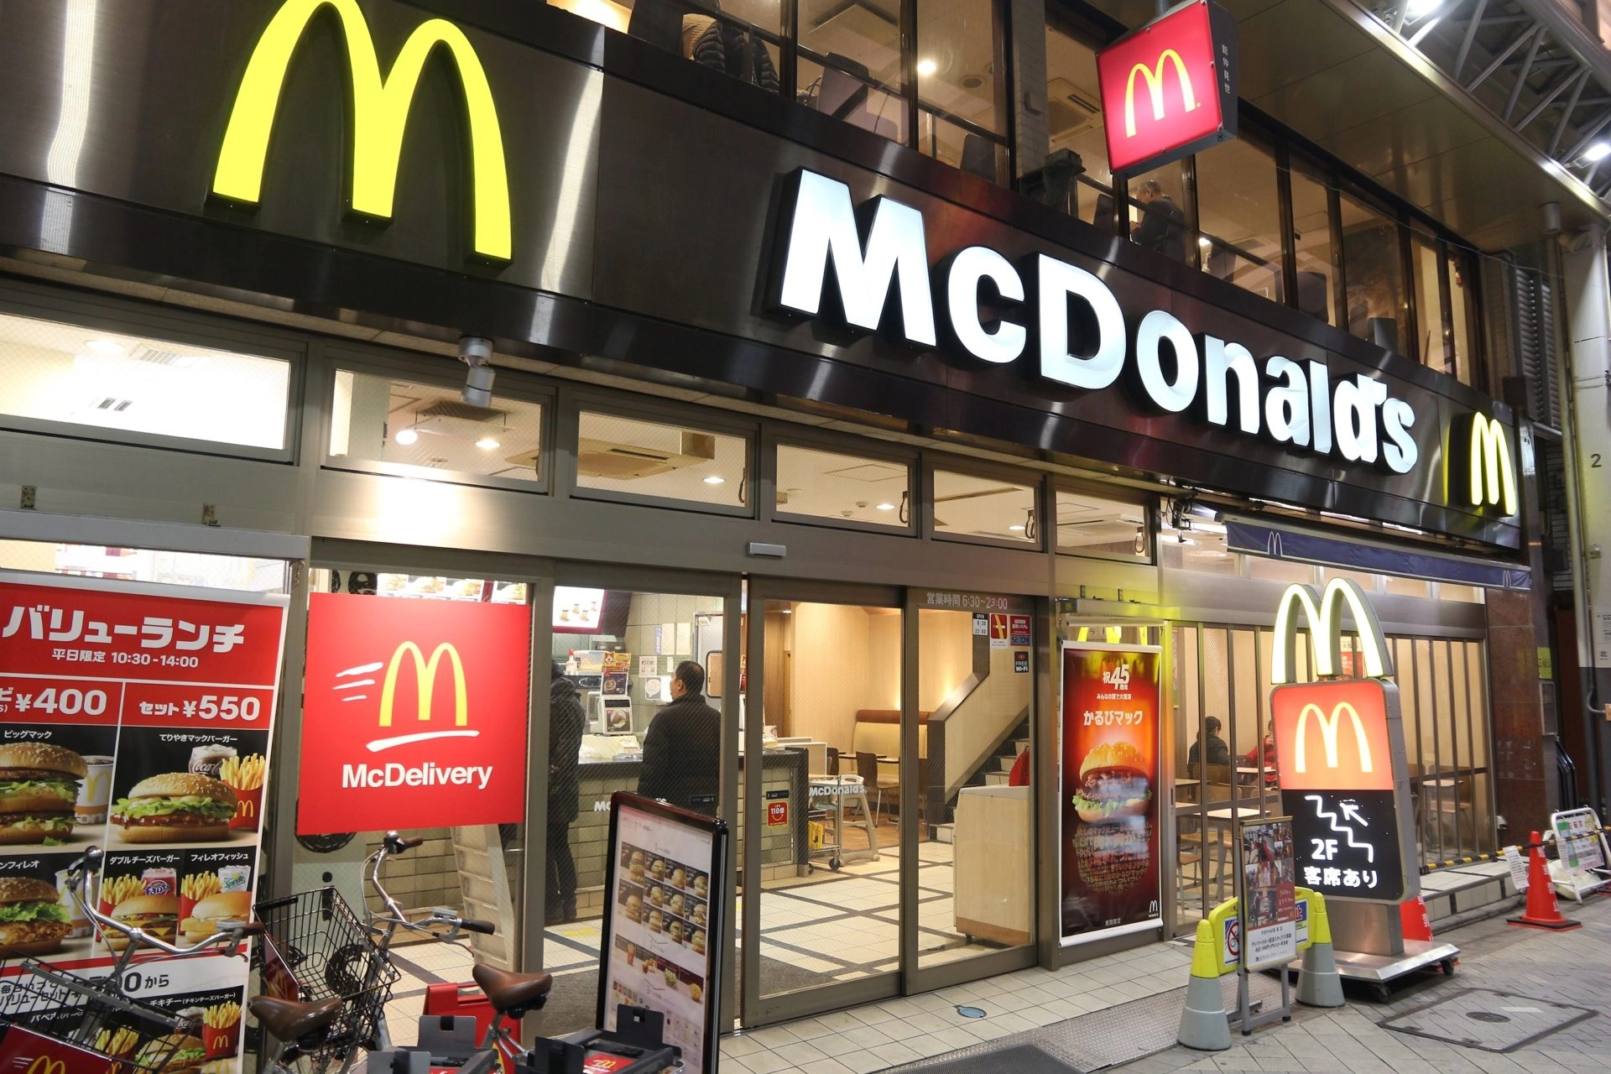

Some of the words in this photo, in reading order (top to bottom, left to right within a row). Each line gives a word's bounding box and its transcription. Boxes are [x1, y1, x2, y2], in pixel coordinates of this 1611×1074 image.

[781, 168, 1418, 475] McDonald's
[1590, 453, 1602, 468] 2
[926, 592, 960, 606] 営業時間
[2, 604, 245, 653] バリューランチ
[52, 648, 106, 664] 平日限定
[15, 687, 108, 715] ¥400
[139, 702, 179, 716] セット
[183, 695, 260, 721] ¥550
[1084, 710, 1143, 726] かるびマック
[4, 730, 52, 739] ビッグマック
[159, 734, 238, 743] てりやきマックバーガー
[341, 762, 493, 790] McDelivery
[190, 852, 249, 862] フィレオフィッシュ
[1311, 838, 1338, 860] 2F
[1303, 866, 1378, 889] 客席あり
